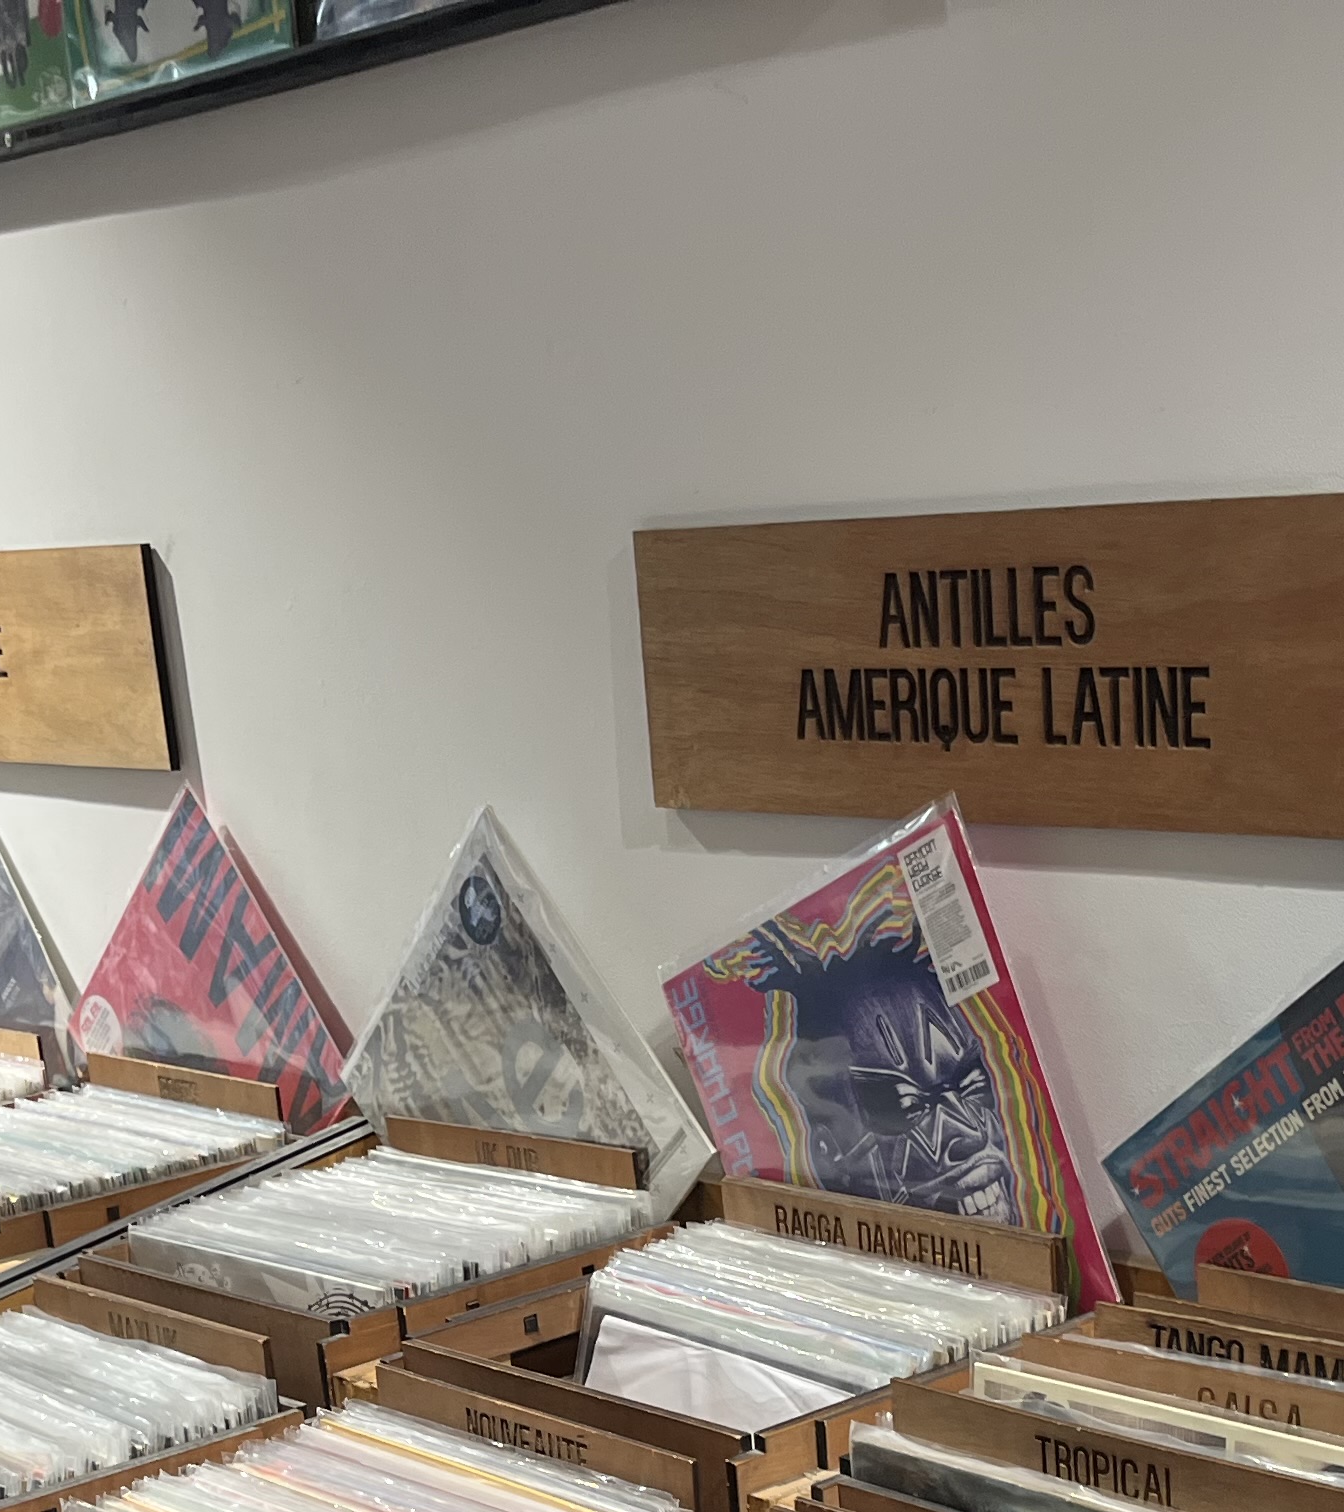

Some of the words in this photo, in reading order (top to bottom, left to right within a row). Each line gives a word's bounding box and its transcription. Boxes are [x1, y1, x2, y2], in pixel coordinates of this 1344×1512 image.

[1, 42, 28, 89] UP
[879, 564, 1096, 649] ANTILLES
[797, 667, 1019, 752] AMERIQUE
[1042, 665, 1212, 749] LATINE
[1129, 1041, 1301, 1210] STRAIGHT
[1291, 1007, 1338, 1050] FROM
[1151, 1201, 1188, 1238] GUTS
[1182, 1163, 1234, 1212] FINEST
[1229, 1108, 1305, 1177] SELECTION
[1302, 1077, 1344, 1121] FROM
[774, 1204, 847, 1247] RAGGA
[1149, 1322, 1245, 1364] TANGO
[1034, 1434, 1172, 1507] TROPICAL
